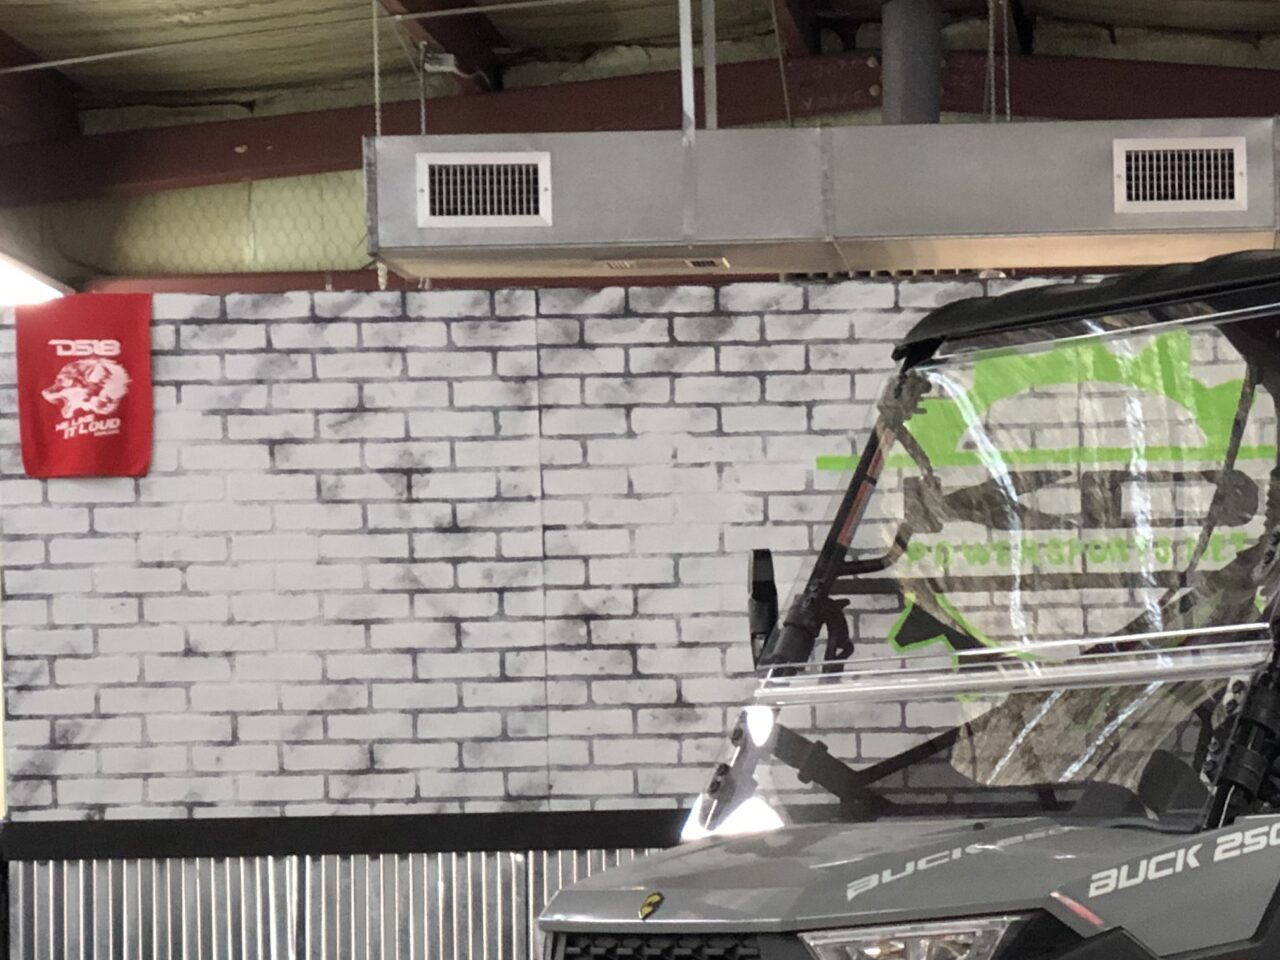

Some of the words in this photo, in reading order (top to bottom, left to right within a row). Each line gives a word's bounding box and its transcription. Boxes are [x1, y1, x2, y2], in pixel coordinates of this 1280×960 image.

[48, 339, 121, 356] DS18
[64, 426, 78, 440] IT
[79, 418, 121, 435] LOUD
[1088, 843, 1204, 898] BUCK
